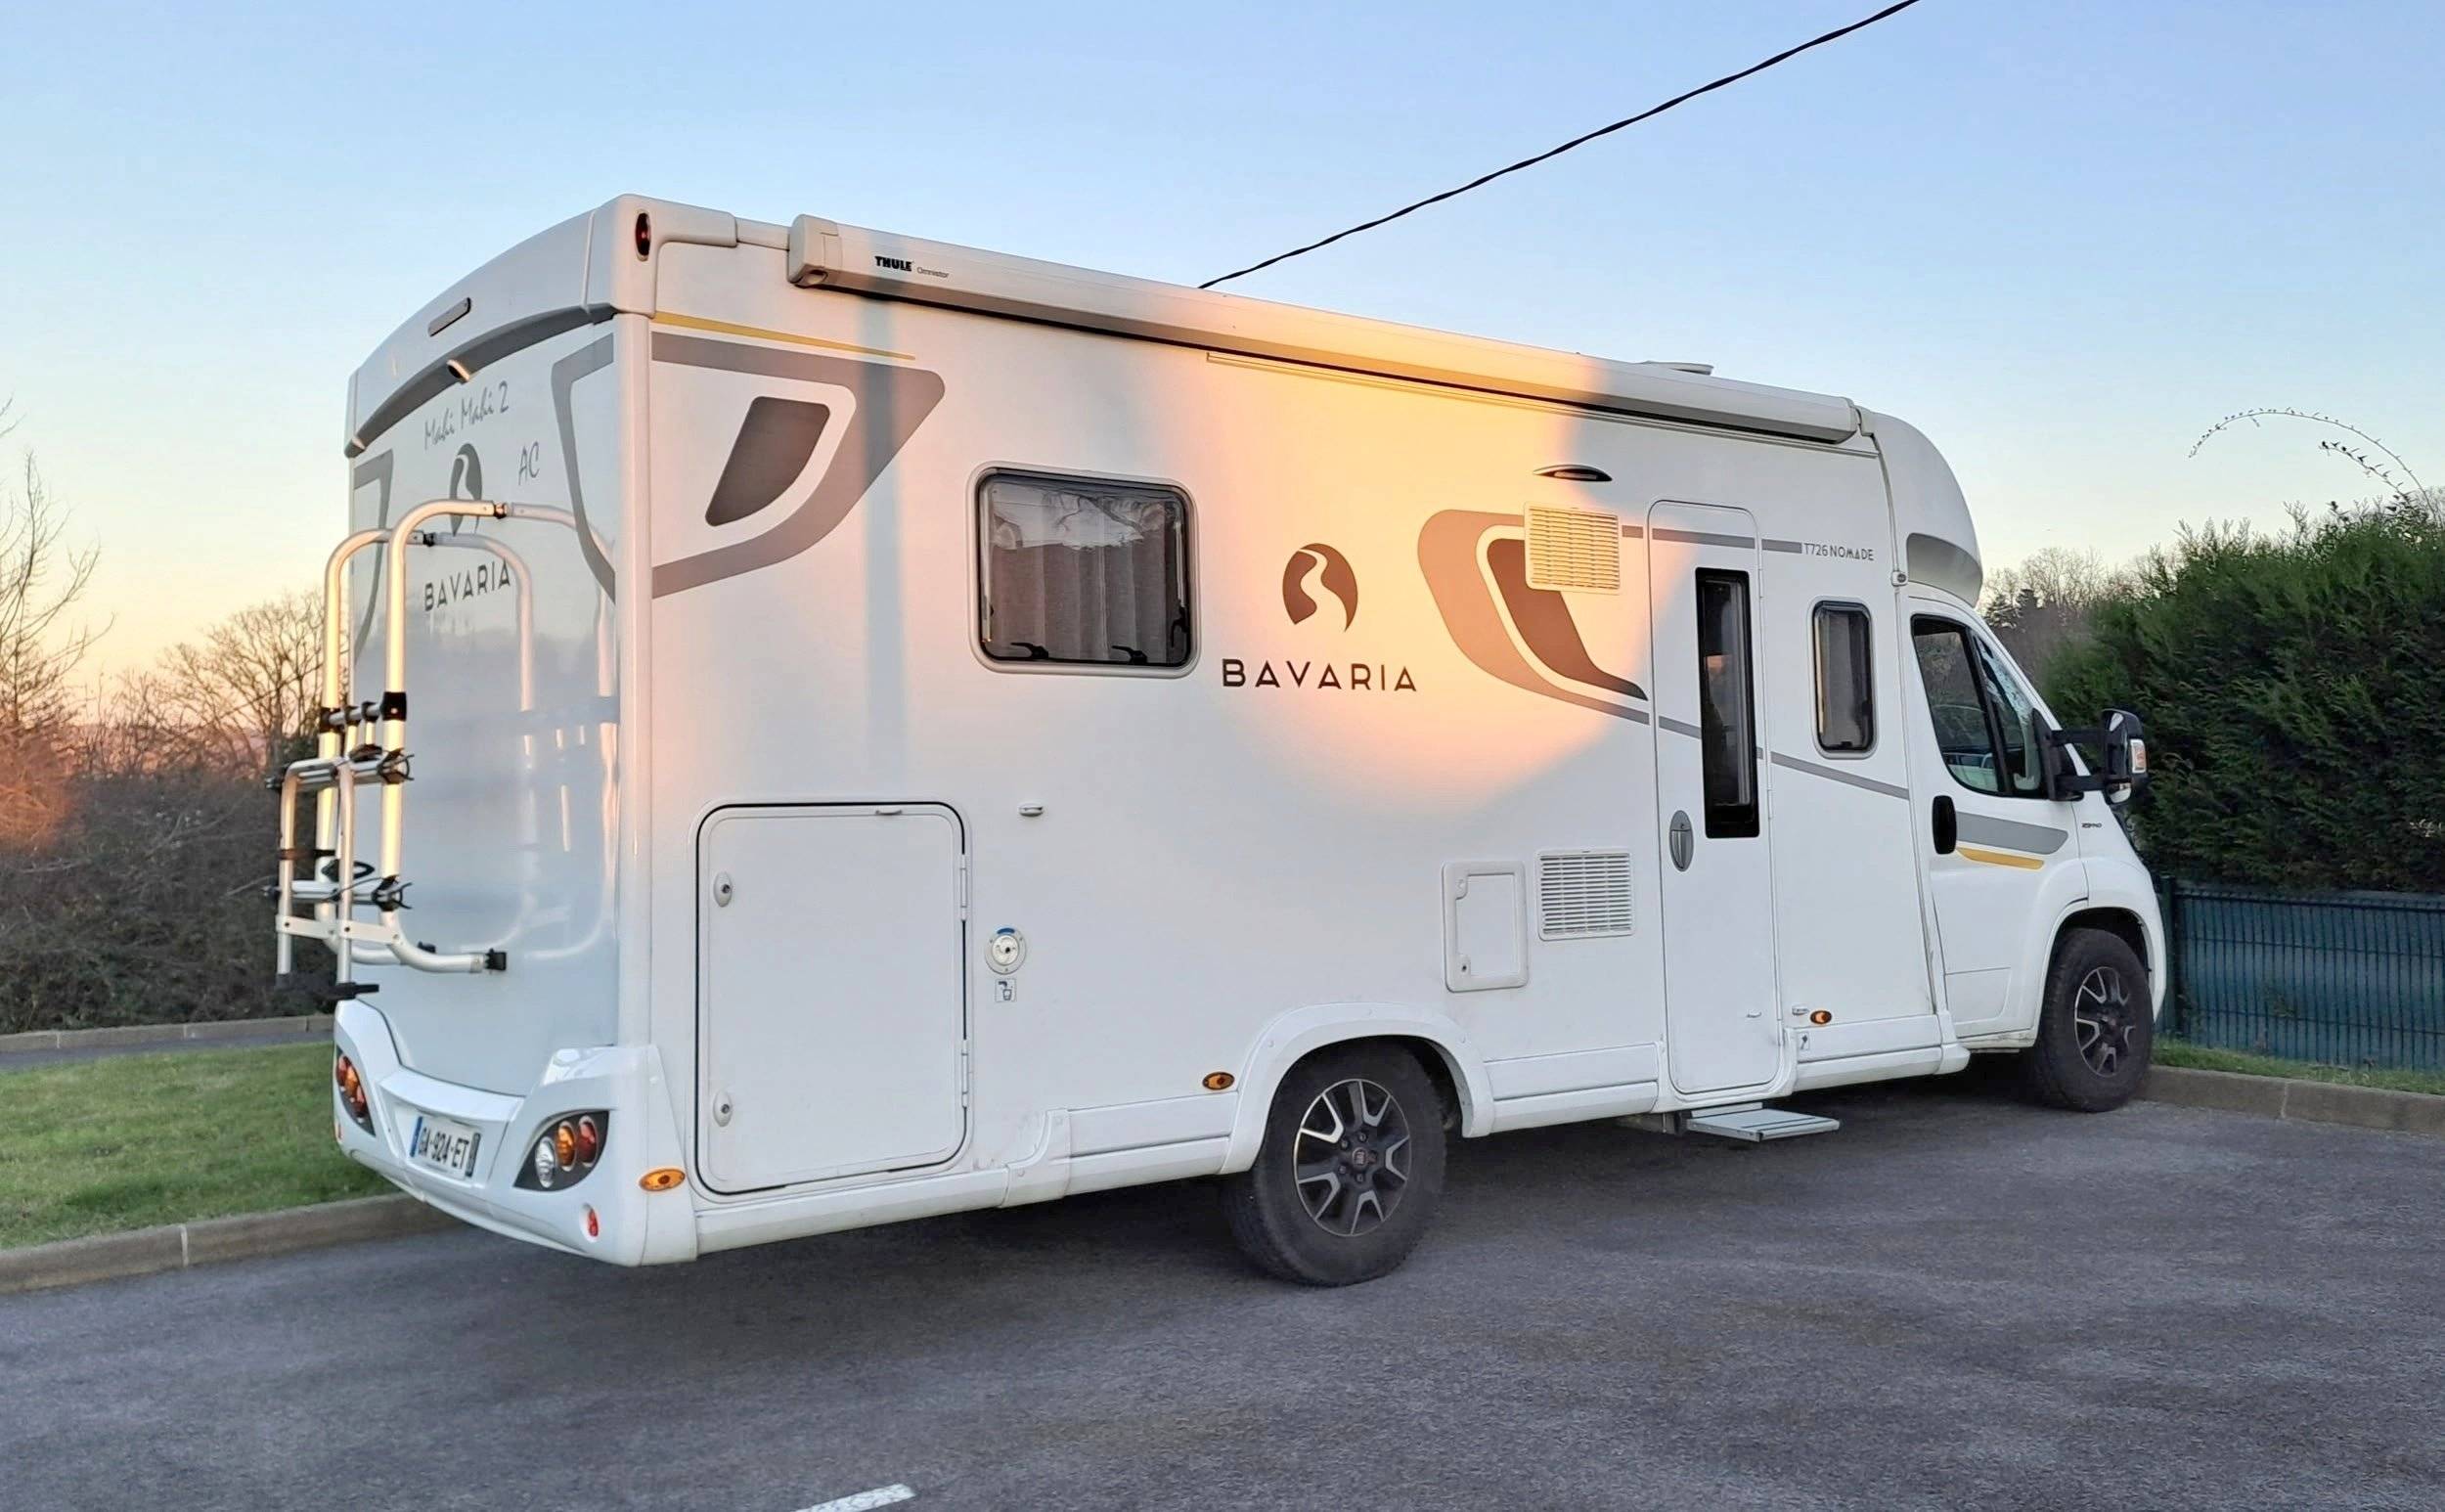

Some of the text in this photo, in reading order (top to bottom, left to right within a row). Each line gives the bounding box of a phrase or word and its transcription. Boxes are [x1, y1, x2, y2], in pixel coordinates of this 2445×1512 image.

[874, 255, 912, 272] THULE
[498, 379, 510, 414] 2
[518, 440, 540, 486] AC
[1803, 543, 1875, 560] T726 NOMADE
[423, 558, 511, 612] BAVARIA
[1222, 658, 1417, 691] BAVARIA
